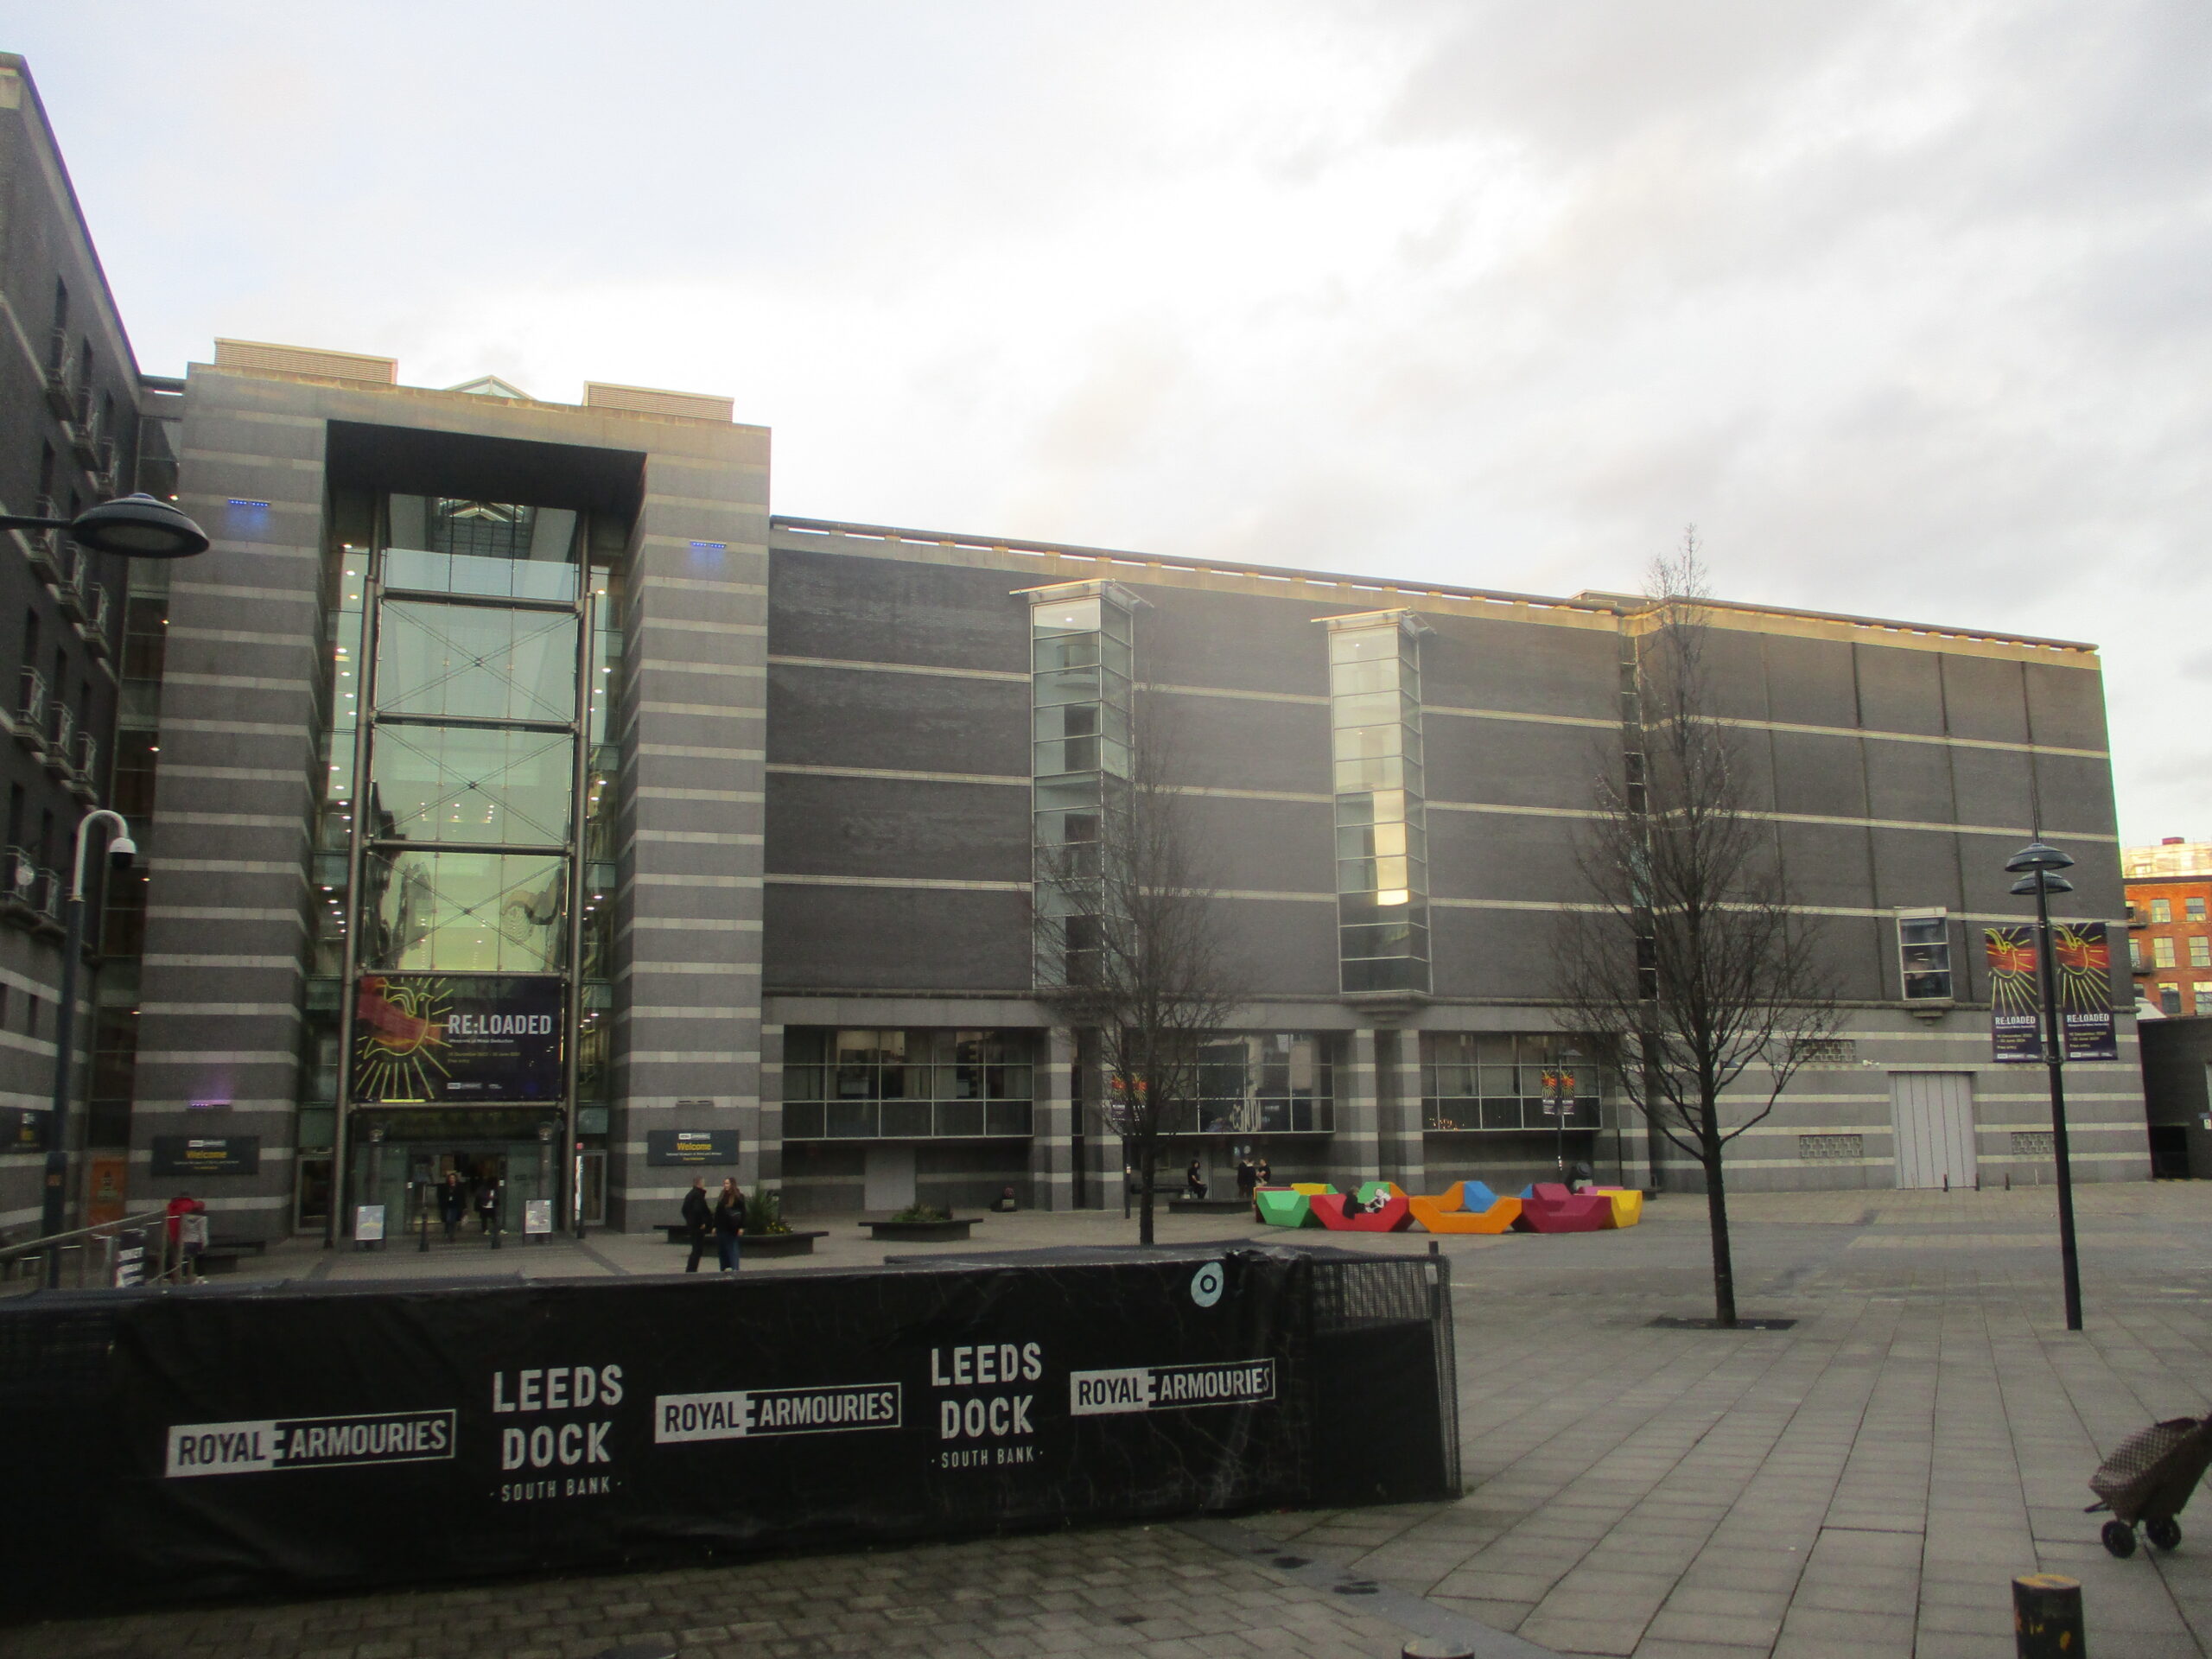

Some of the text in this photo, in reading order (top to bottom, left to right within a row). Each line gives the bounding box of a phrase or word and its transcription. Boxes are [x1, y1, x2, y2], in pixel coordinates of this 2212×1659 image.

[448, 1014, 552, 1034] RE:LOADED
[931, 1342, 1042, 1387] LEEDS
[493, 1363, 623, 1414] LEEDS
[1078, 1367, 1270, 1407] ROYAL ARMOURIES
[664, 1392, 893, 1433] ROYAL ARMOURIES
[941, 1395, 1034, 1440] DOCK
[177, 1419, 447, 1466] ROYAL ARMOURIES
[502, 1421, 612, 1471] DOCK
[941, 1446, 1034, 1469] SOUTH BANK
[501, 1476, 611, 1503] SOUTH BANK
